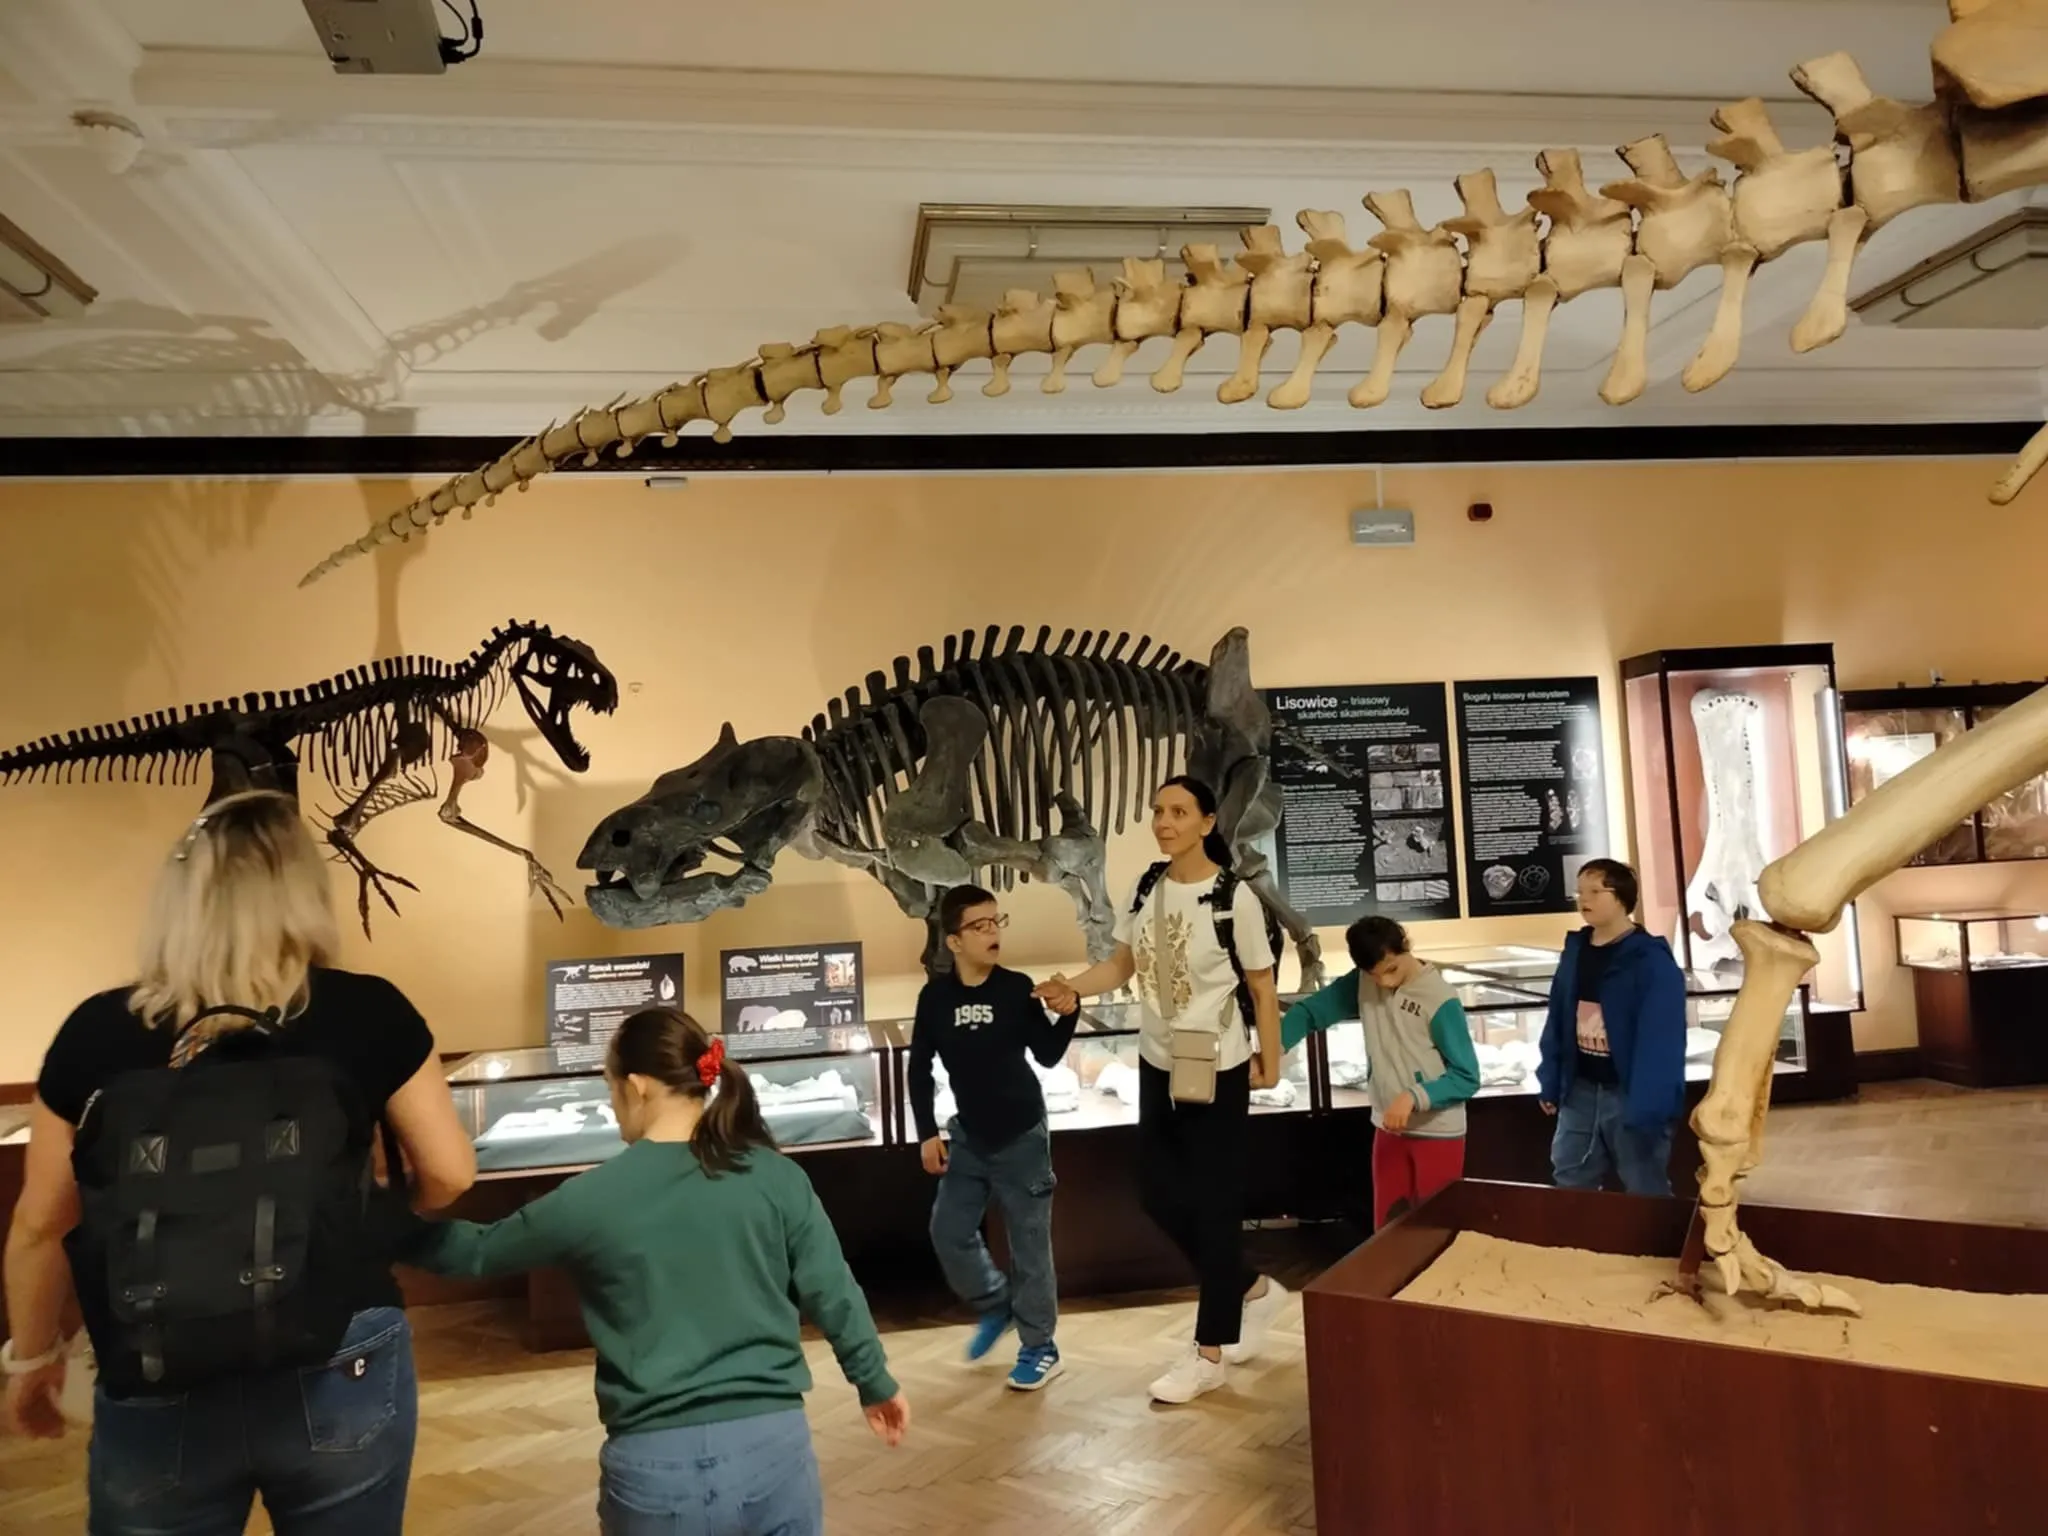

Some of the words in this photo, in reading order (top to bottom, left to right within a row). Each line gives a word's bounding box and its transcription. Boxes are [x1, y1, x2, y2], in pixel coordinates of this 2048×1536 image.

[1276, 695, 1338, 710] Lisowice
[1350, 696, 1391, 706] triasowy
[1463, 692, 1491, 702] Bogaty
[1527, 690, 1571, 700] ekosystem
[1297, 709, 1338, 720] skarbiec
[1340, 706, 1410, 719] skamieniałości
[758, 954, 784, 964] Wielki
[954, 1004, 994, 1027] 1965
